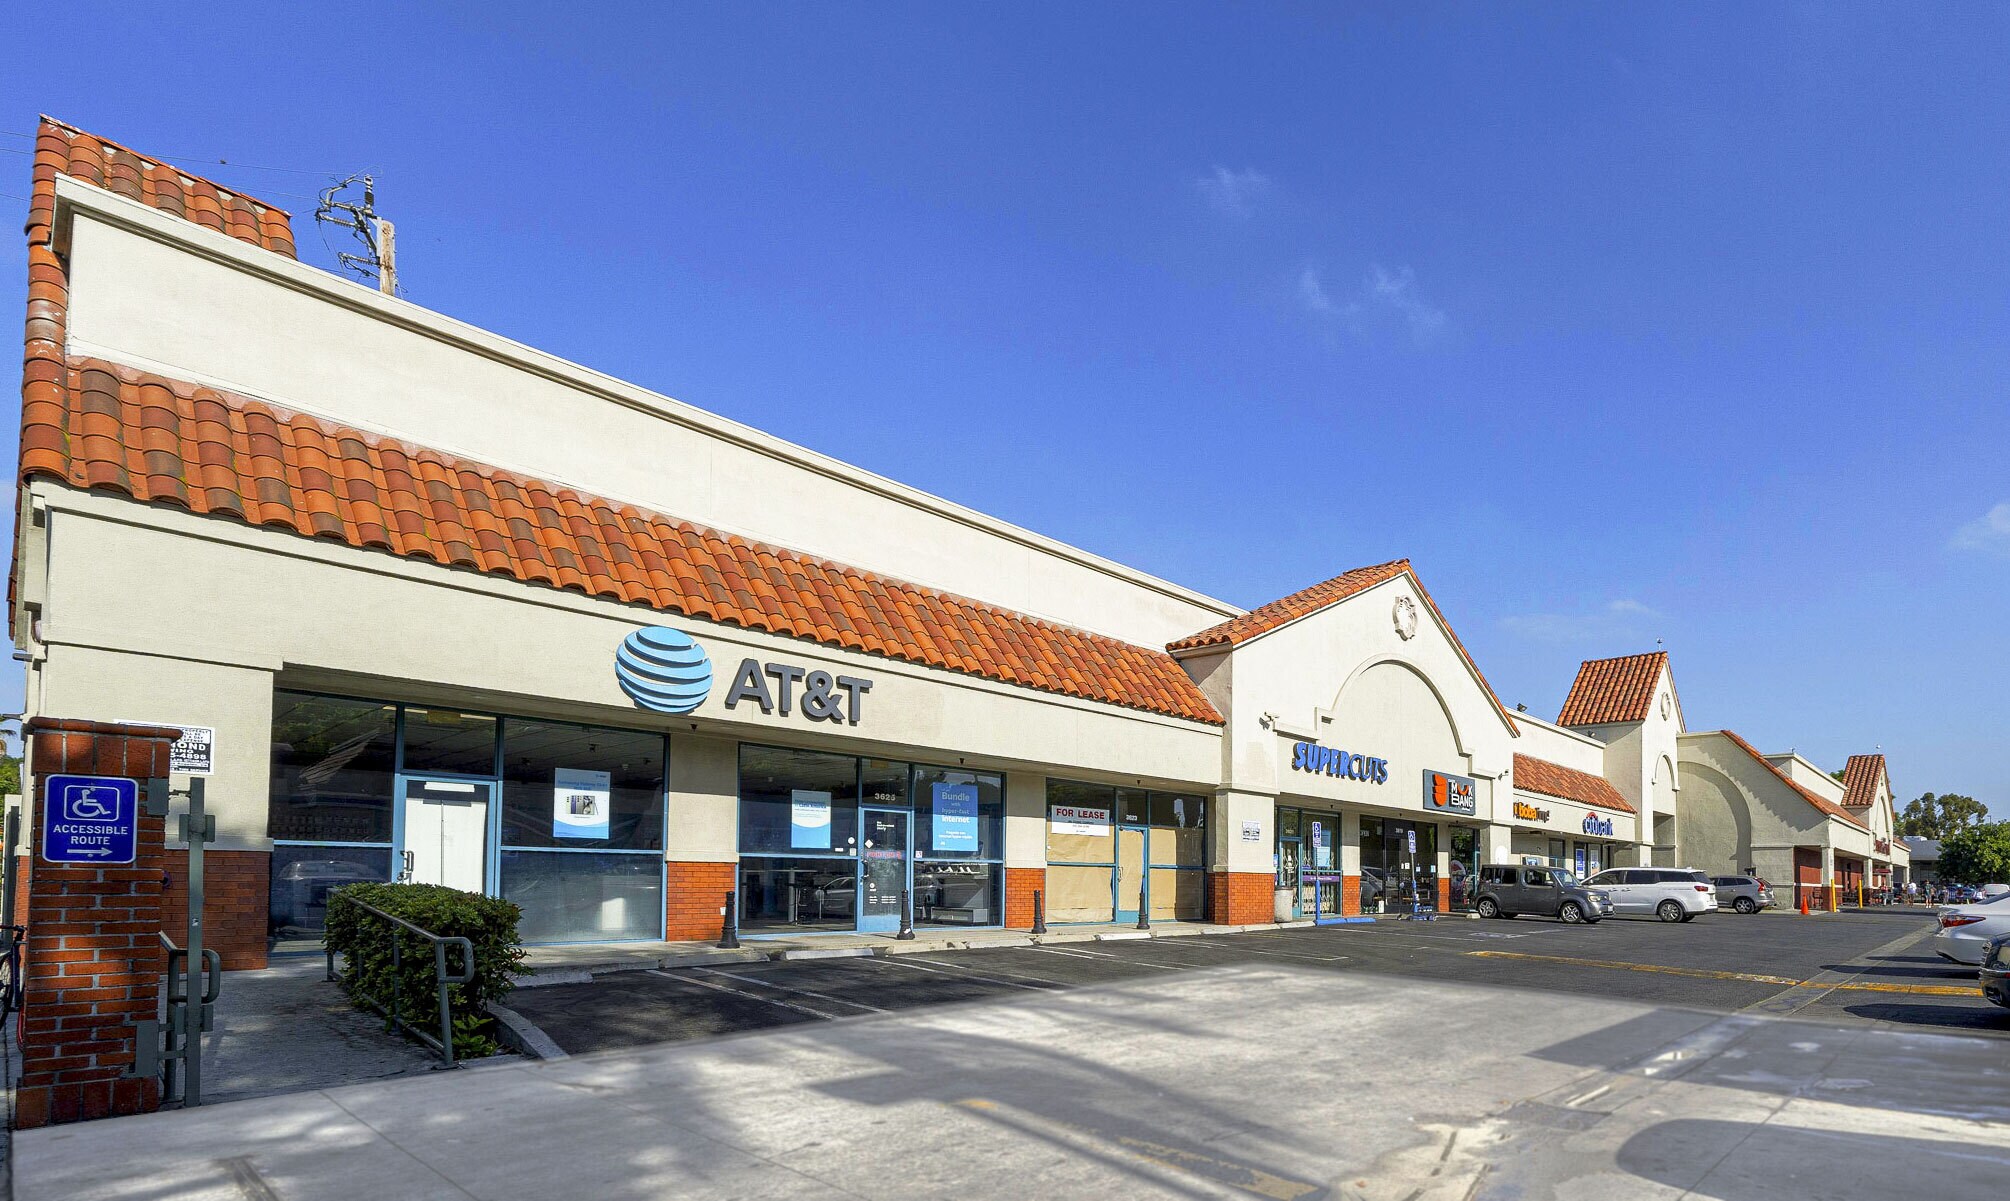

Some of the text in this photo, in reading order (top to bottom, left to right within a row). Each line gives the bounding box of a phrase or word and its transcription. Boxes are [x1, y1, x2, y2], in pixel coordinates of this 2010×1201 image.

[725, 657, 874, 726] AT&T
[1292, 742, 1389, 785] SUPERCUTS
[942, 792, 970, 801] Bundle
[1451, 782, 1473, 797] MUK
[1451, 793, 1473, 808] BANG
[1056, 808, 1105, 820] FOR LEASE
[53, 824, 129, 835] ACCESSIBLE
[1582, 815, 1613, 836] citibank
[70, 835, 111, 845] ROUTE
